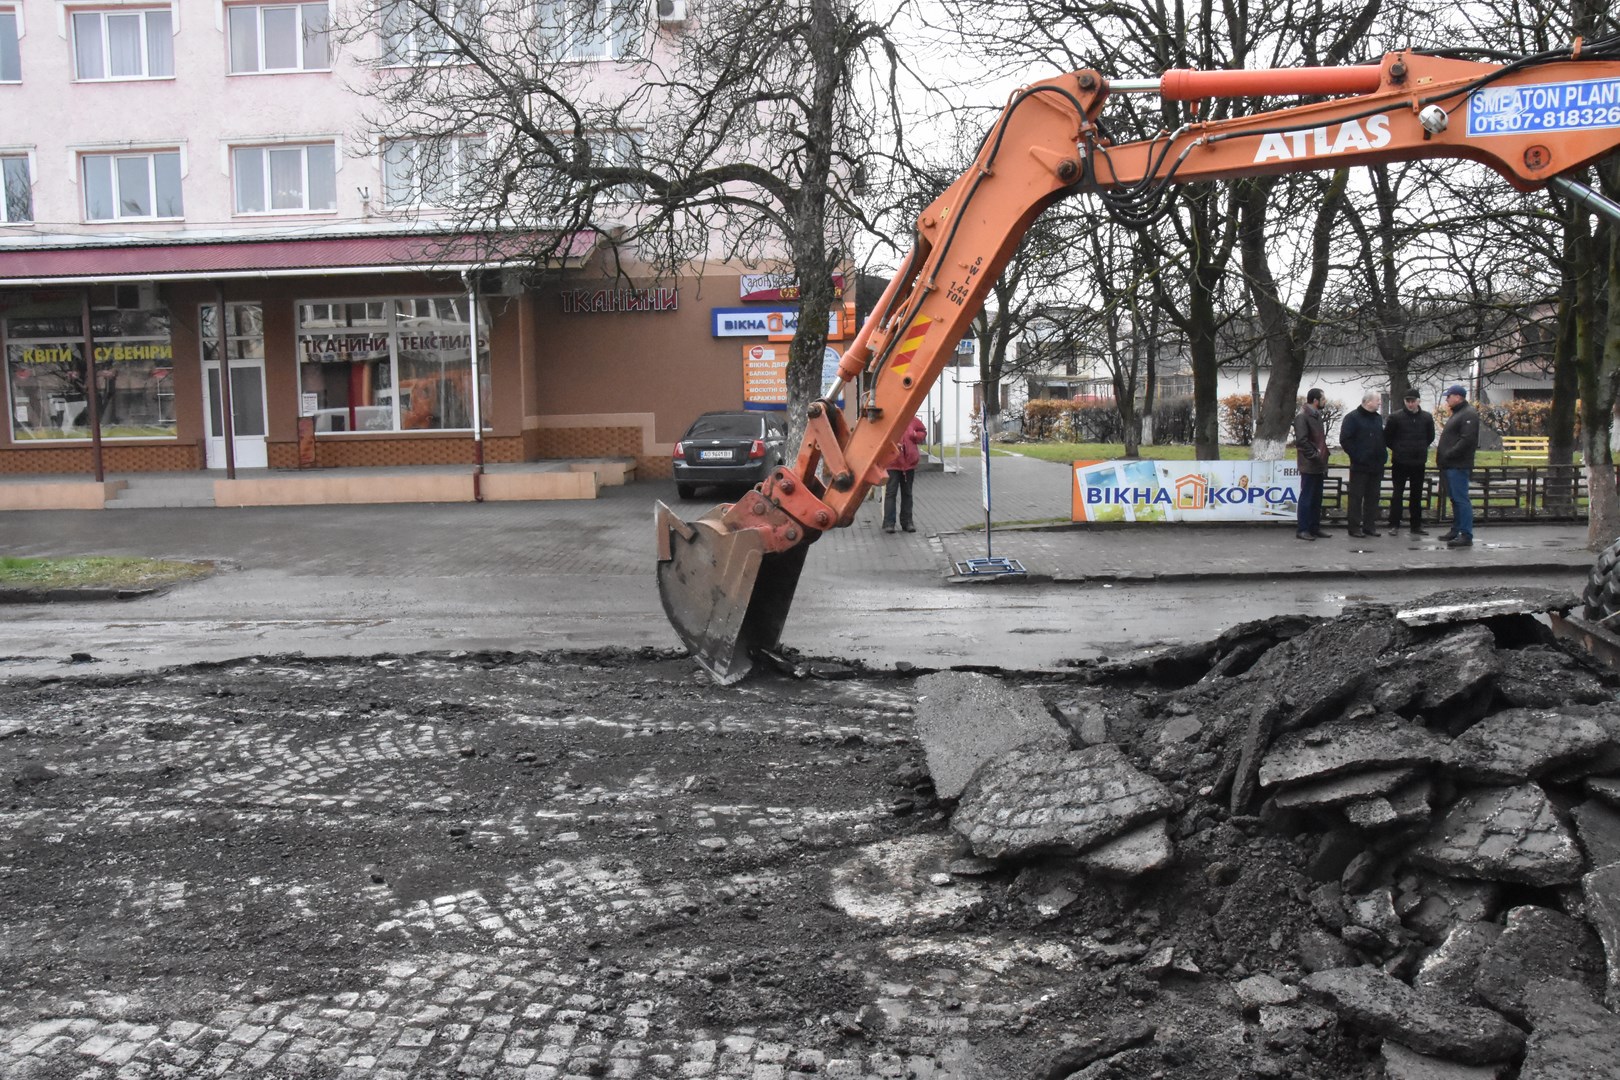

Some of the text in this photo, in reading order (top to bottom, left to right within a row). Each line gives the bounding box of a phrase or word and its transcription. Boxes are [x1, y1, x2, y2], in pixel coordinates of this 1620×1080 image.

[1473, 88, 1560, 114] SMEATON
[1253, 115, 1392, 163] ATLAS
[561, 288, 678, 312] ТКАНИНИ
[946, 290, 964, 306] TON
[724, 319, 766, 331] ВІКНА
[303, 334, 486, 353] ТКАНИНИ ТЕКСТИЛЬ
[23, 346, 173, 364] КВІТИ СУВЕНІРИ
[1283, 467, 1300, 477] REH
[1086, 486, 1298, 504] ВІКНА КОРСА
